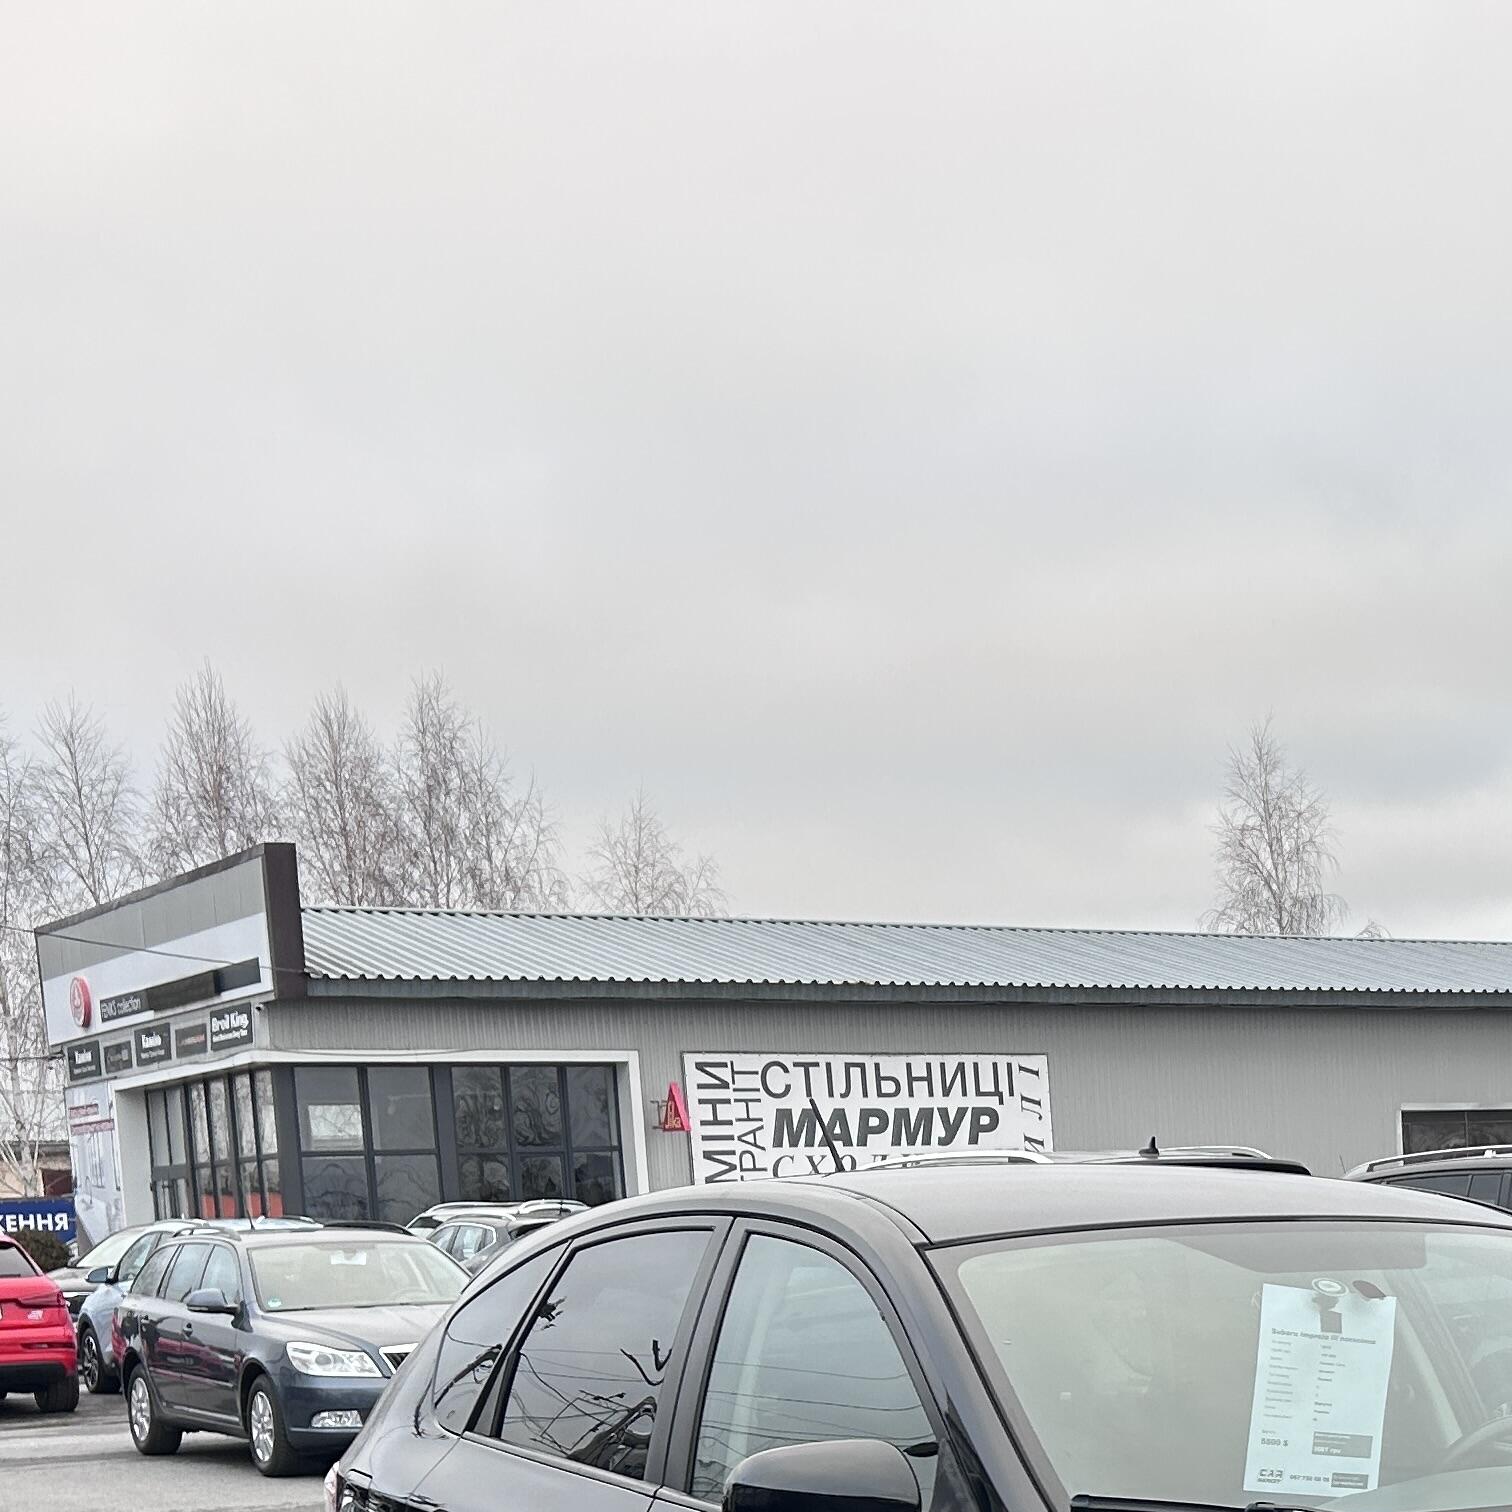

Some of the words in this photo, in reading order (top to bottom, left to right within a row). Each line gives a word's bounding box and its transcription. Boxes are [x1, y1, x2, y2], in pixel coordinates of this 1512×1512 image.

[761, 1060, 1015, 1105] СТІЛЬНИЦІ
[730, 1060, 768, 1181] РАНІТ
[772, 1107, 1000, 1148] МАРМУР
